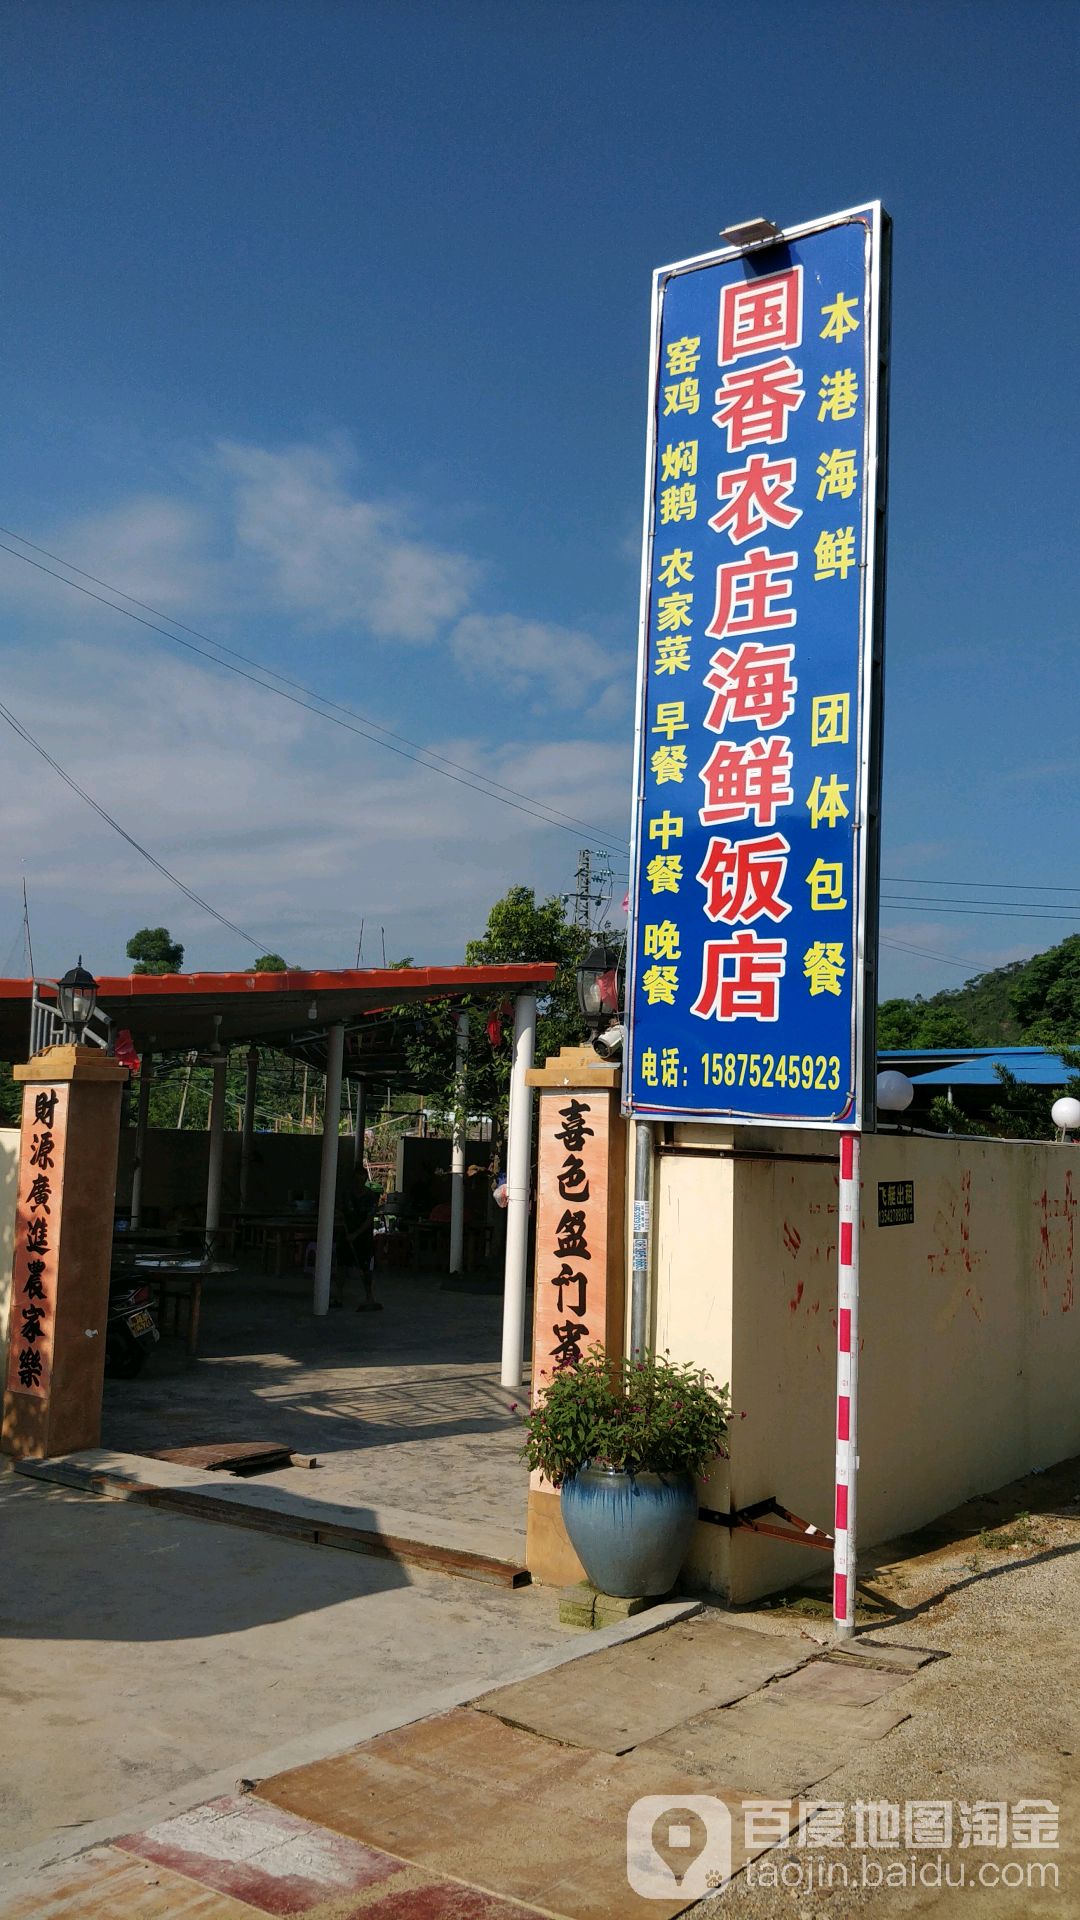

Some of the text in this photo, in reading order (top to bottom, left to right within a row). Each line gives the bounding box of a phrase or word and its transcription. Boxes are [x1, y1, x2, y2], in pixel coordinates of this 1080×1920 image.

[641, 335, 701, 1007] 窑鸡 焖鹅 农家菜 早餐 中餐 晚餐
[690, 264, 806, 1023] 国香农庄海鲜饭店
[802, 292, 860, 998] 本港海鲜 团体包餐
[701, 1052, 841, 1091] 15875245923
